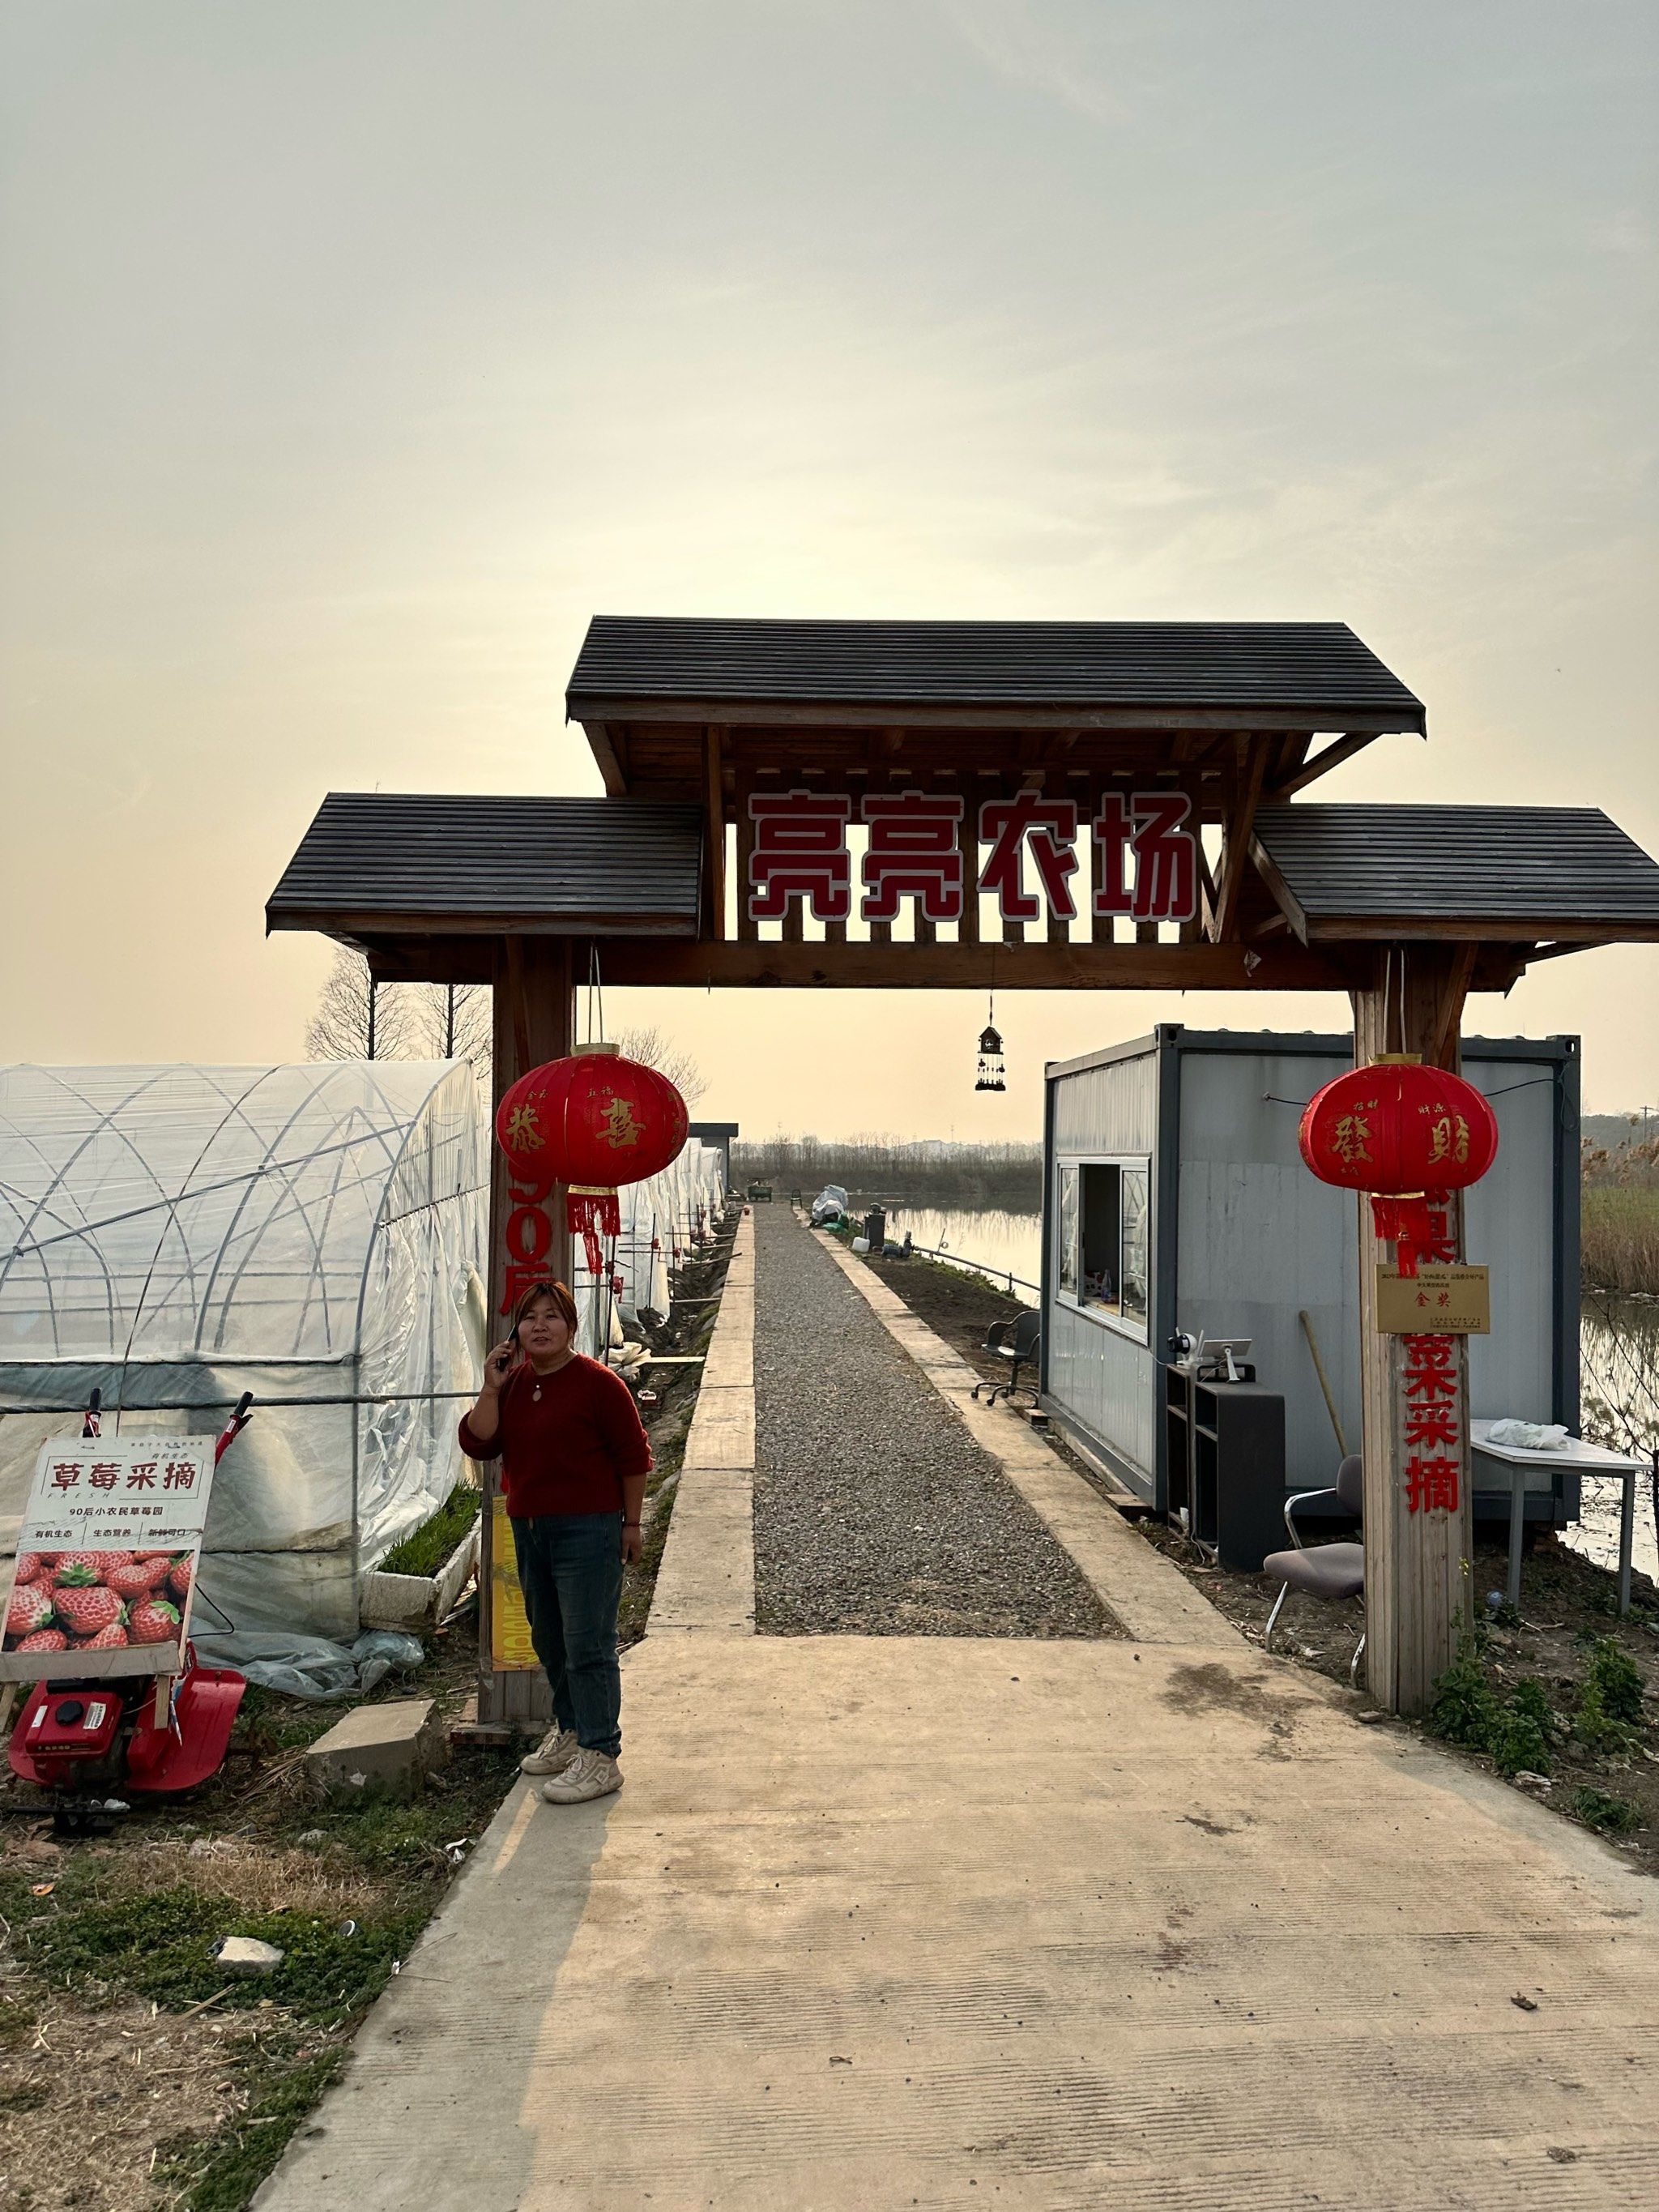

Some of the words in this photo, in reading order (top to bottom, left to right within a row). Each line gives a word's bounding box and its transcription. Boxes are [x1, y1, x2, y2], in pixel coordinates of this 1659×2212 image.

[748, 788, 1197, 922] 亮亮农场
[595, 1097, 646, 1148] 喜
[1414, 1292, 1452, 1307] 金奖
[50, 1462, 197, 1491] 草莓采摘
[69, 1506, 164, 1516] 90后小农民草莓园
[35, 1530, 73, 1538] 有机生态
[93, 1528, 132, 1537] 生态营养
